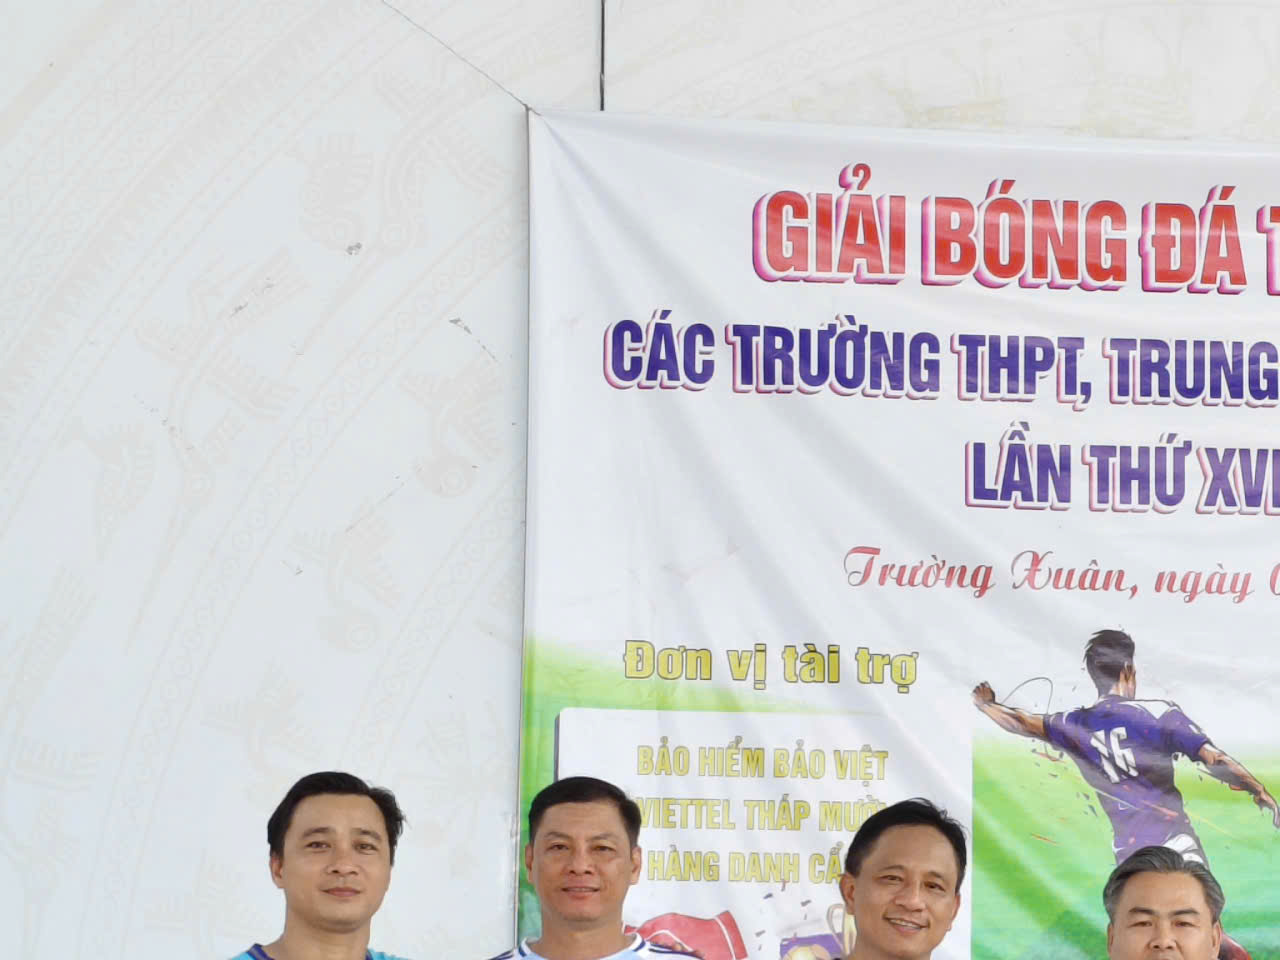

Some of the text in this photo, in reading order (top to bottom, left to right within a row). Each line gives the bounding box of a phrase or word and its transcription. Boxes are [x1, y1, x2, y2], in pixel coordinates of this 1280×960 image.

[753, 163, 907, 285] GIẢI
[921, 179, 1128, 291] BÓNG
[1138, 185, 1247, 296] ĐÁ
[603, 309, 716, 390] CÁC
[724, 315, 941, 401] TRƯỜNG
[950, 333, 1093, 411] THPT,
[1102, 337, 1279, 408] TRUNG
[965, 421, 1072, 512] LẦN
[1081, 432, 1193, 515] THỨ
[843, 546, 996, 598] Trường
[1009, 550, 1139, 600] Xuân,
[1153, 563, 1255, 604] ngày
[622, 640, 919, 694] Đơn vị tài trợ
[636, 735, 889, 787] BẢO HIỂM BẢO VIỆT
[1089, 726, 1139, 785] 16
[635, 794, 887, 832] VIETTEL THÁP MƯỜ
[647, 844, 720, 882] HÀNG
[728, 850, 801, 884] DANH
